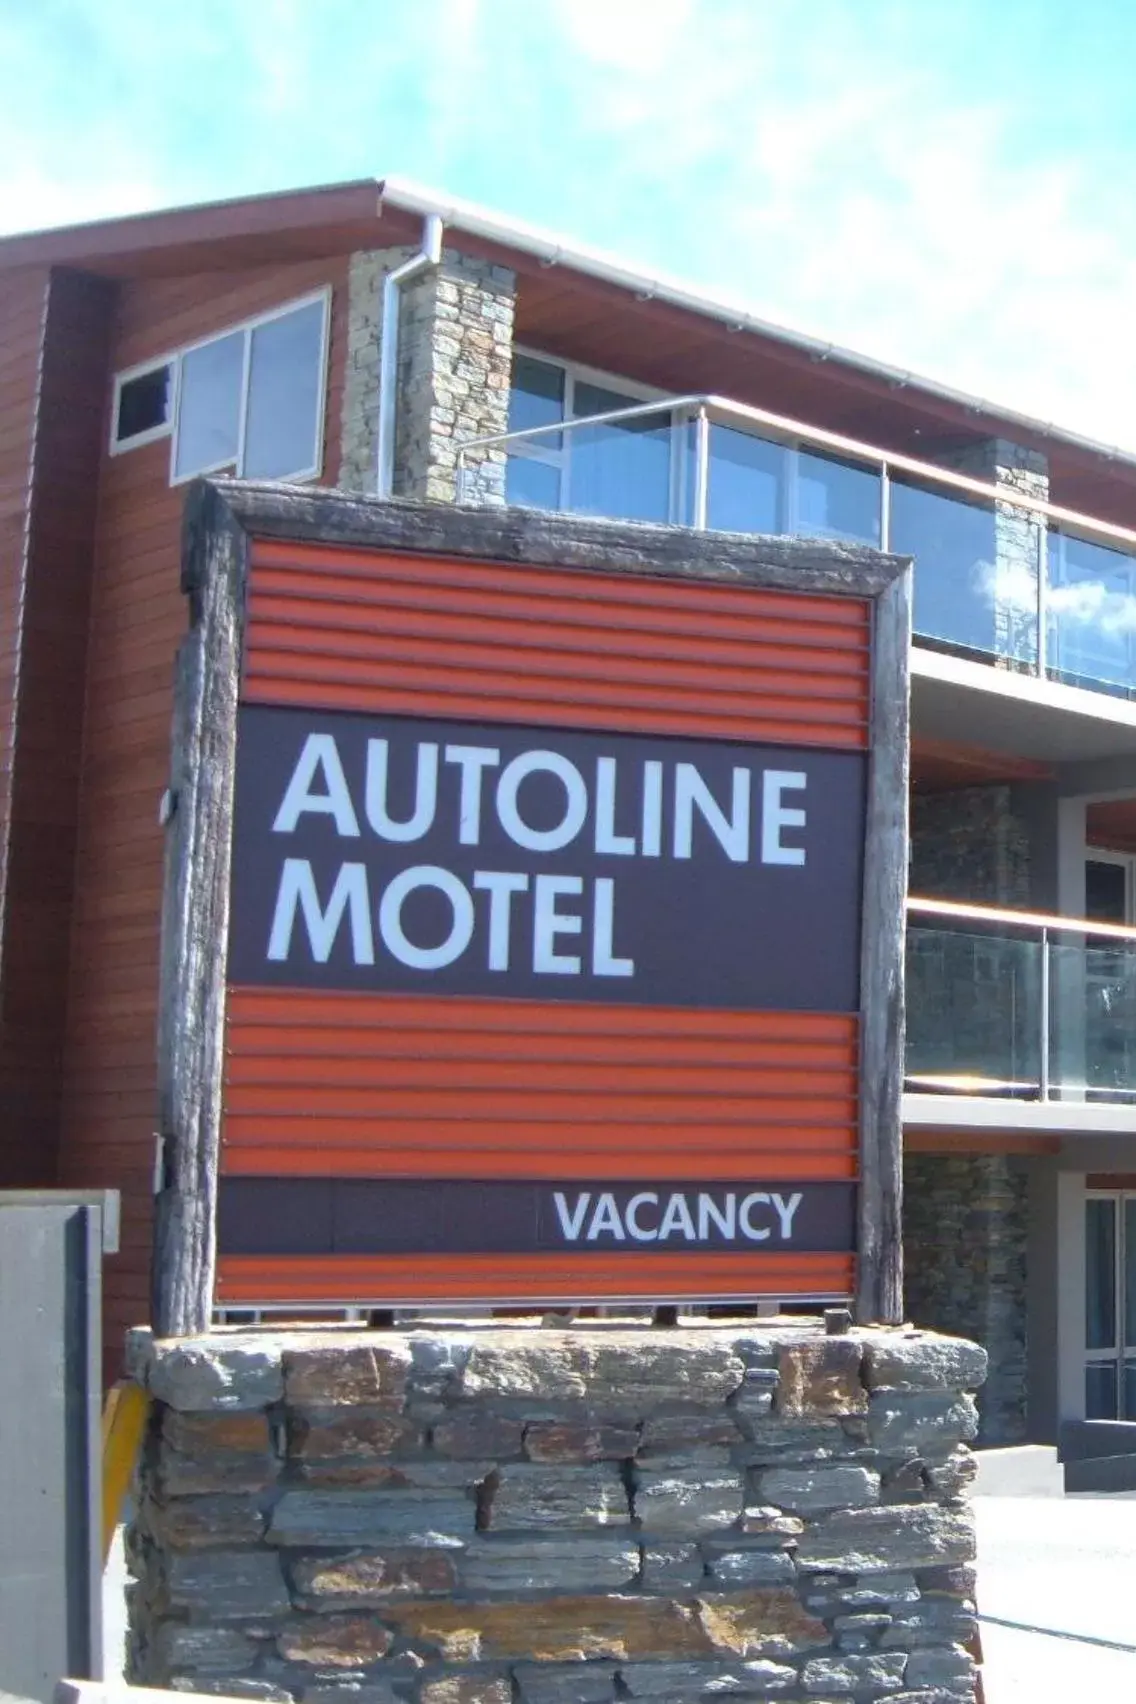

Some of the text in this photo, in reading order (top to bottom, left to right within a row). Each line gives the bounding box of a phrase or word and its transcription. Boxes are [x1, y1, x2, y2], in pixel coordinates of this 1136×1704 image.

[272, 733, 807, 865] AUTOLINE
[266, 858, 634, 976] MOTEL
[553, 1192, 803, 1240] VACANCY
